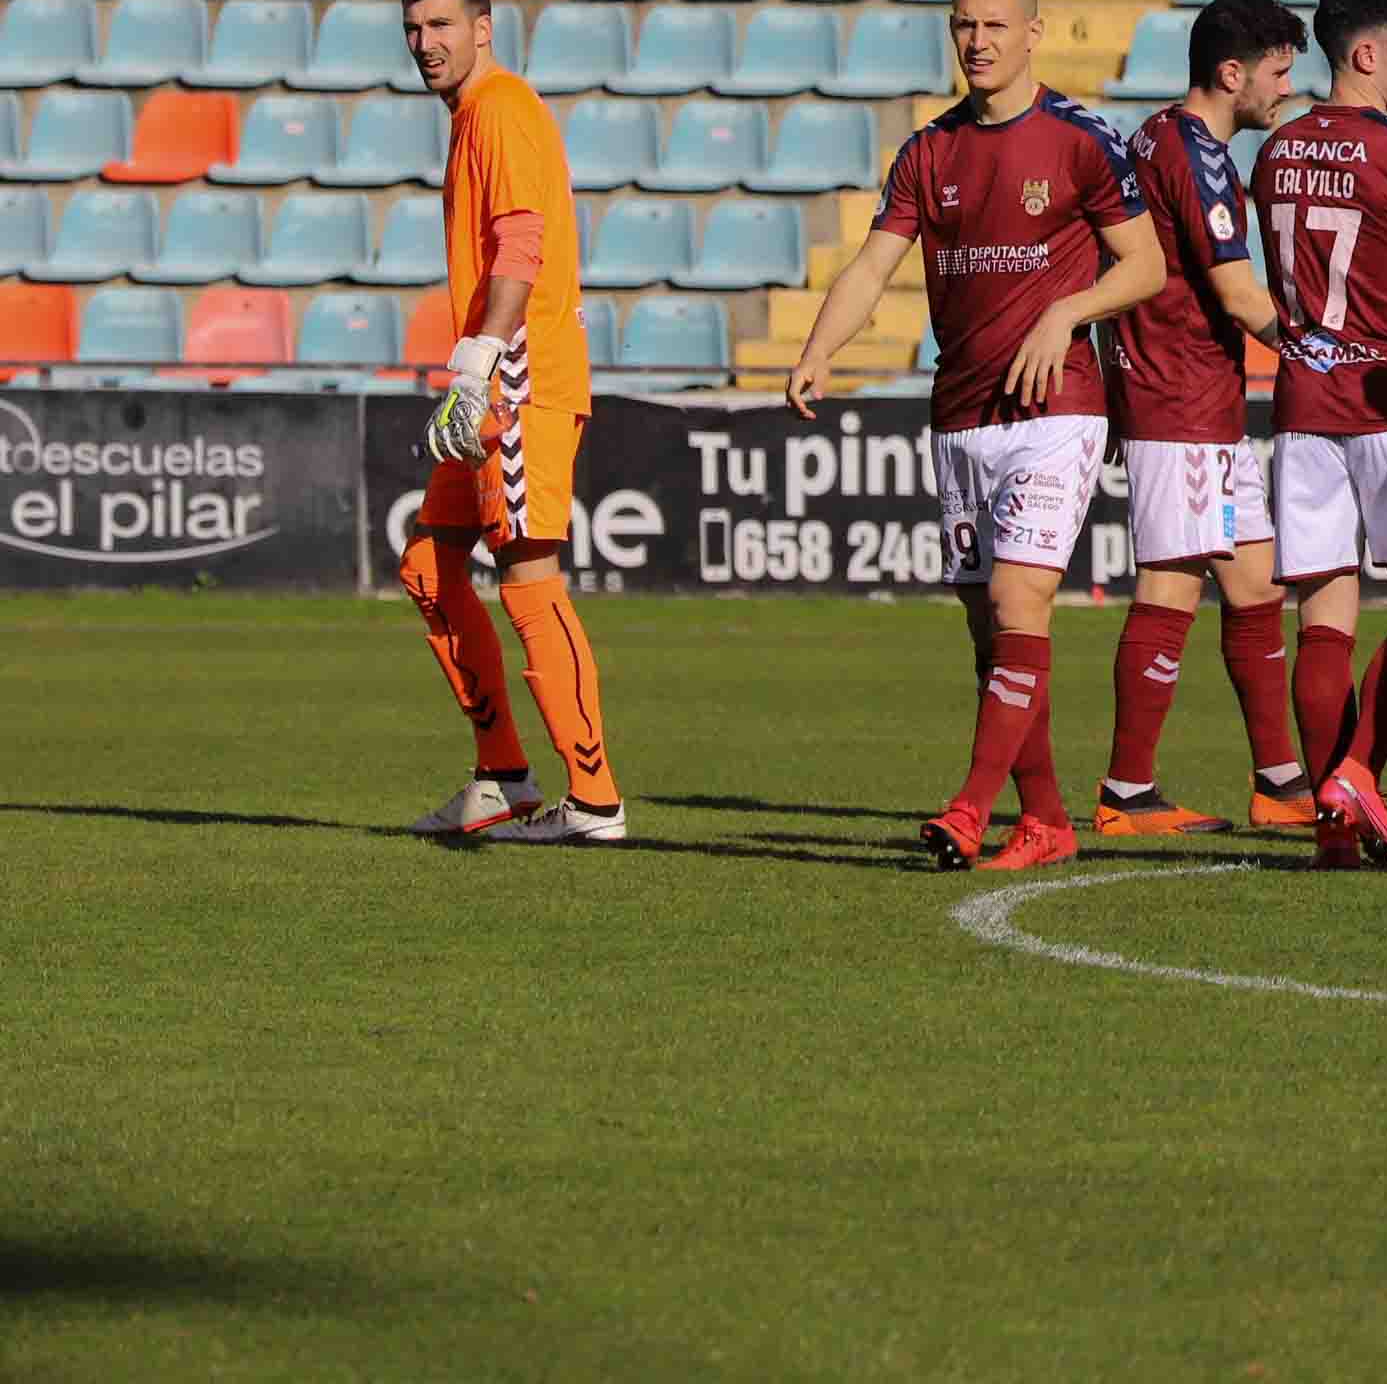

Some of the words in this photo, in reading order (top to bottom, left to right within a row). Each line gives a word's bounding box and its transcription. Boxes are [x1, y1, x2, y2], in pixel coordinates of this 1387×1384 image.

[1271, 202, 1363, 332] 17
[688, 432, 766, 496] Tu
[11, 478, 74, 537] el
[100, 478, 262, 552] pilar
[733, 521, 831, 584] 658
